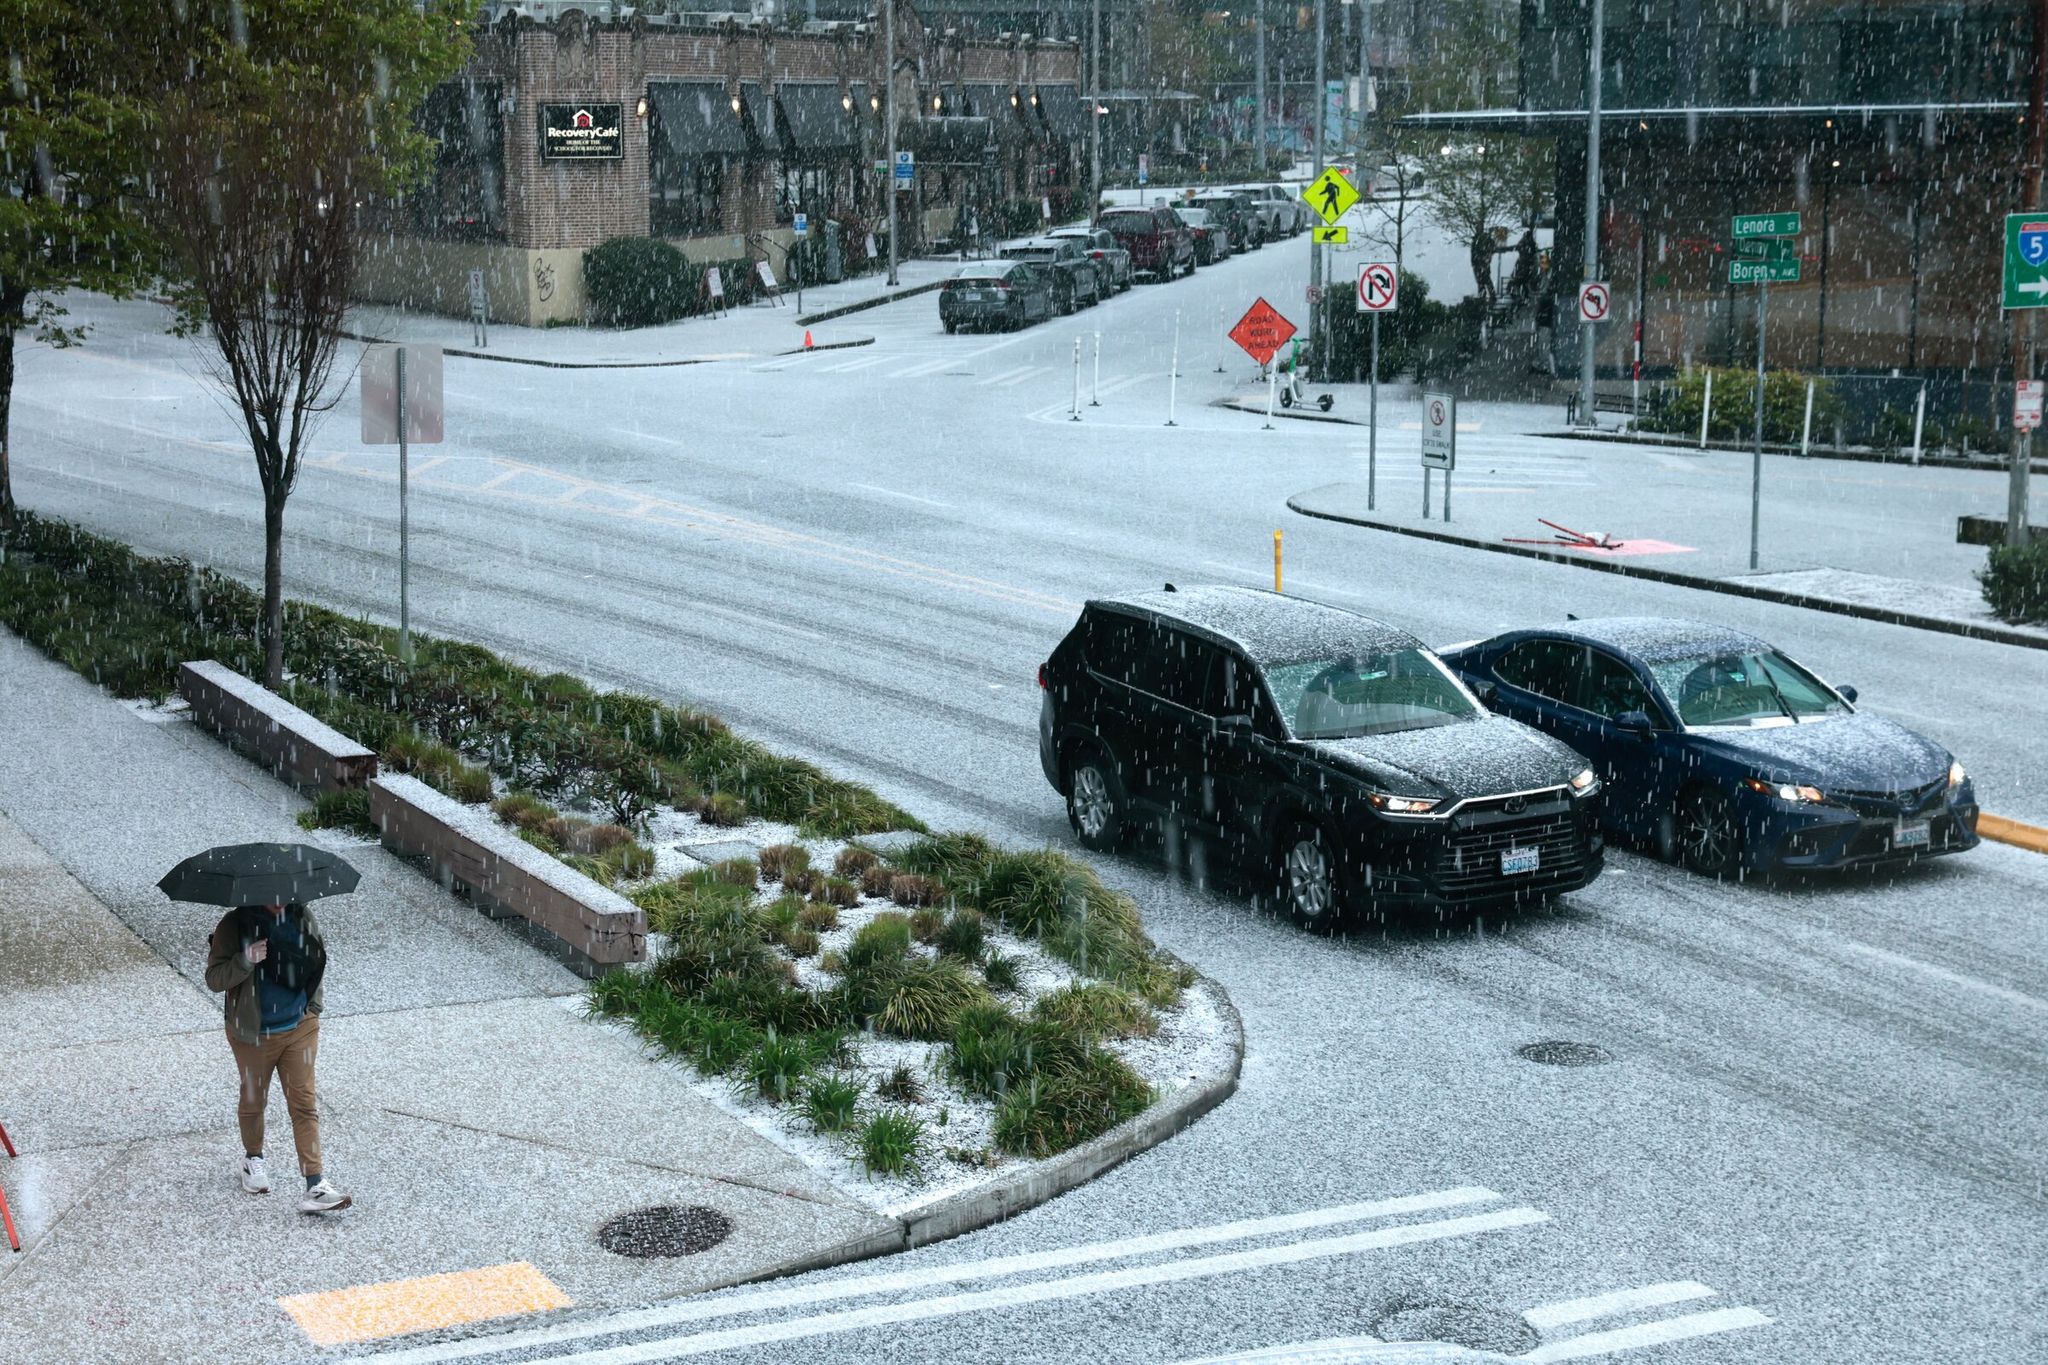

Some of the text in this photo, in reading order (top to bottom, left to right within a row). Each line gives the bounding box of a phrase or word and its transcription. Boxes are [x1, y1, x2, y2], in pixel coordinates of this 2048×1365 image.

[547, 127, 619, 139] RecoveryCafé
[1735, 219, 1775, 234] Lenora
[2030, 236, 2043, 258] 5
[1733, 263, 1768, 279] Boren
[1250, 316, 1274, 324] ROAD
[1250, 328, 1276, 336] WORK
[1248, 340, 1279, 350] AHEAD
[1432, 429, 1442, 437] USE
